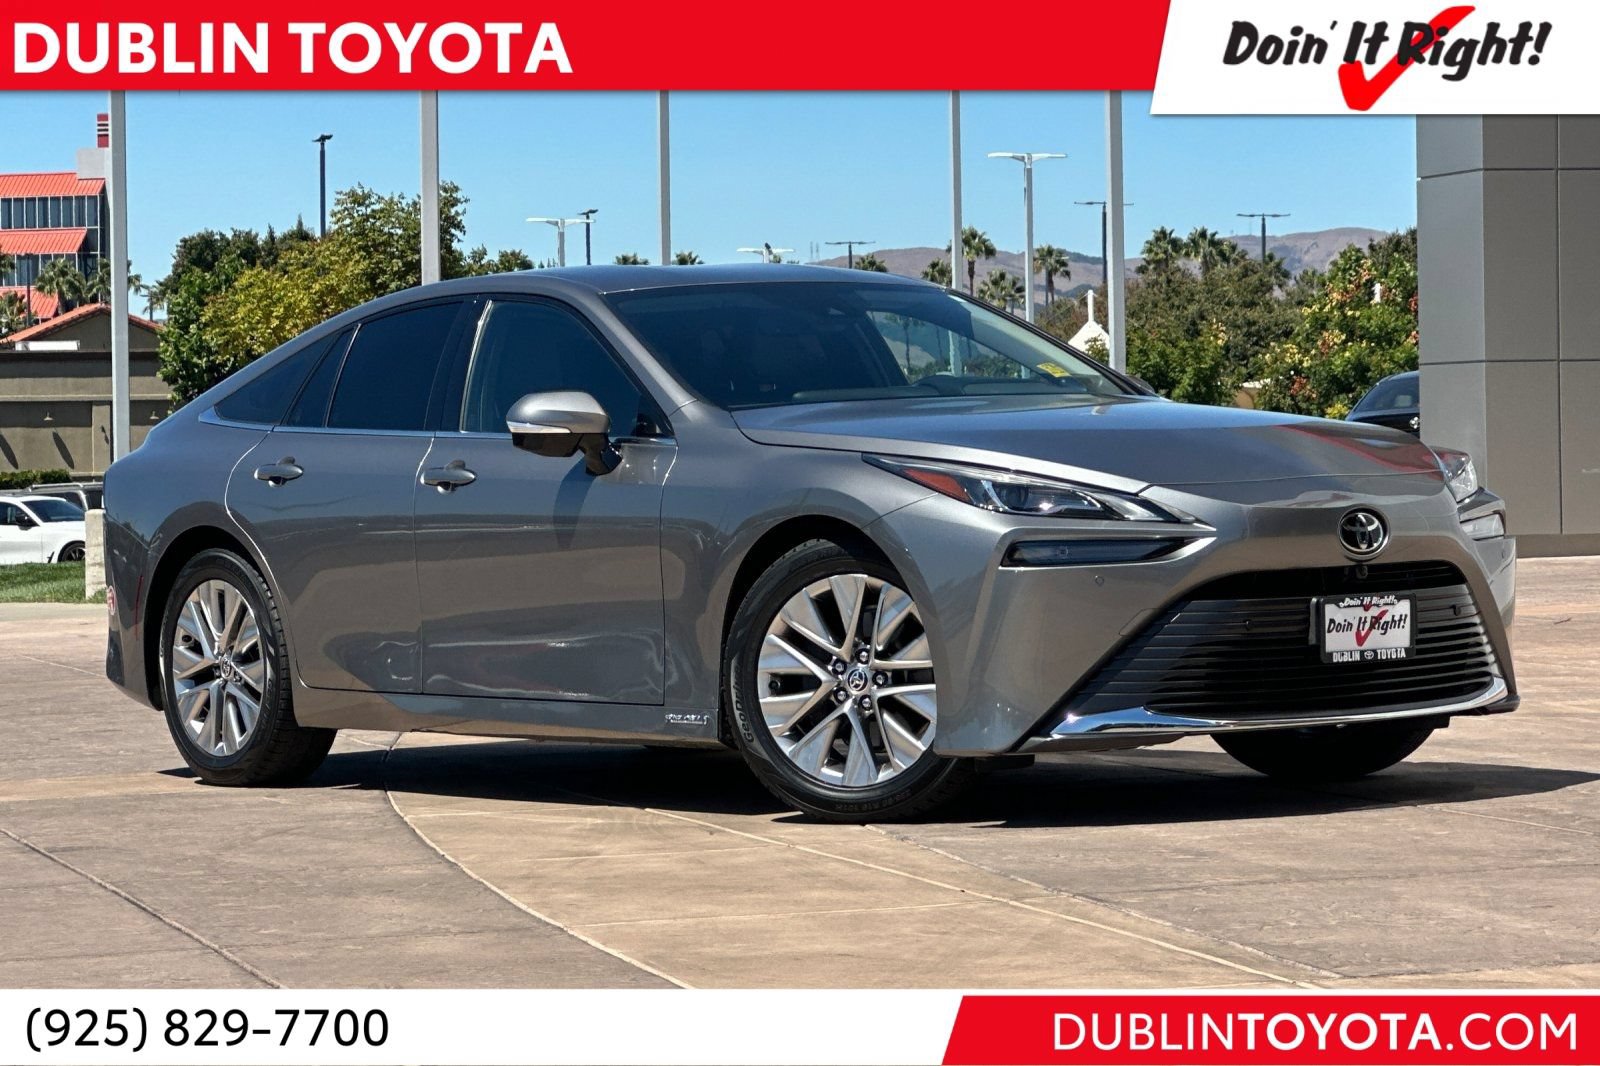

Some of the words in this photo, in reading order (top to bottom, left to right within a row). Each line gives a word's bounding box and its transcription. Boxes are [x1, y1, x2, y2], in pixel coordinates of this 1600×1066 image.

[1372, 595, 1395, 607] Right!
[1327, 616, 1356, 634] Doin'
[1358, 616, 1368, 631] It
[1369, 614, 1408, 635] Right!
[1333, 651, 1361, 663] DUBLIN
[1377, 648, 1406, 660] TOYOTA
